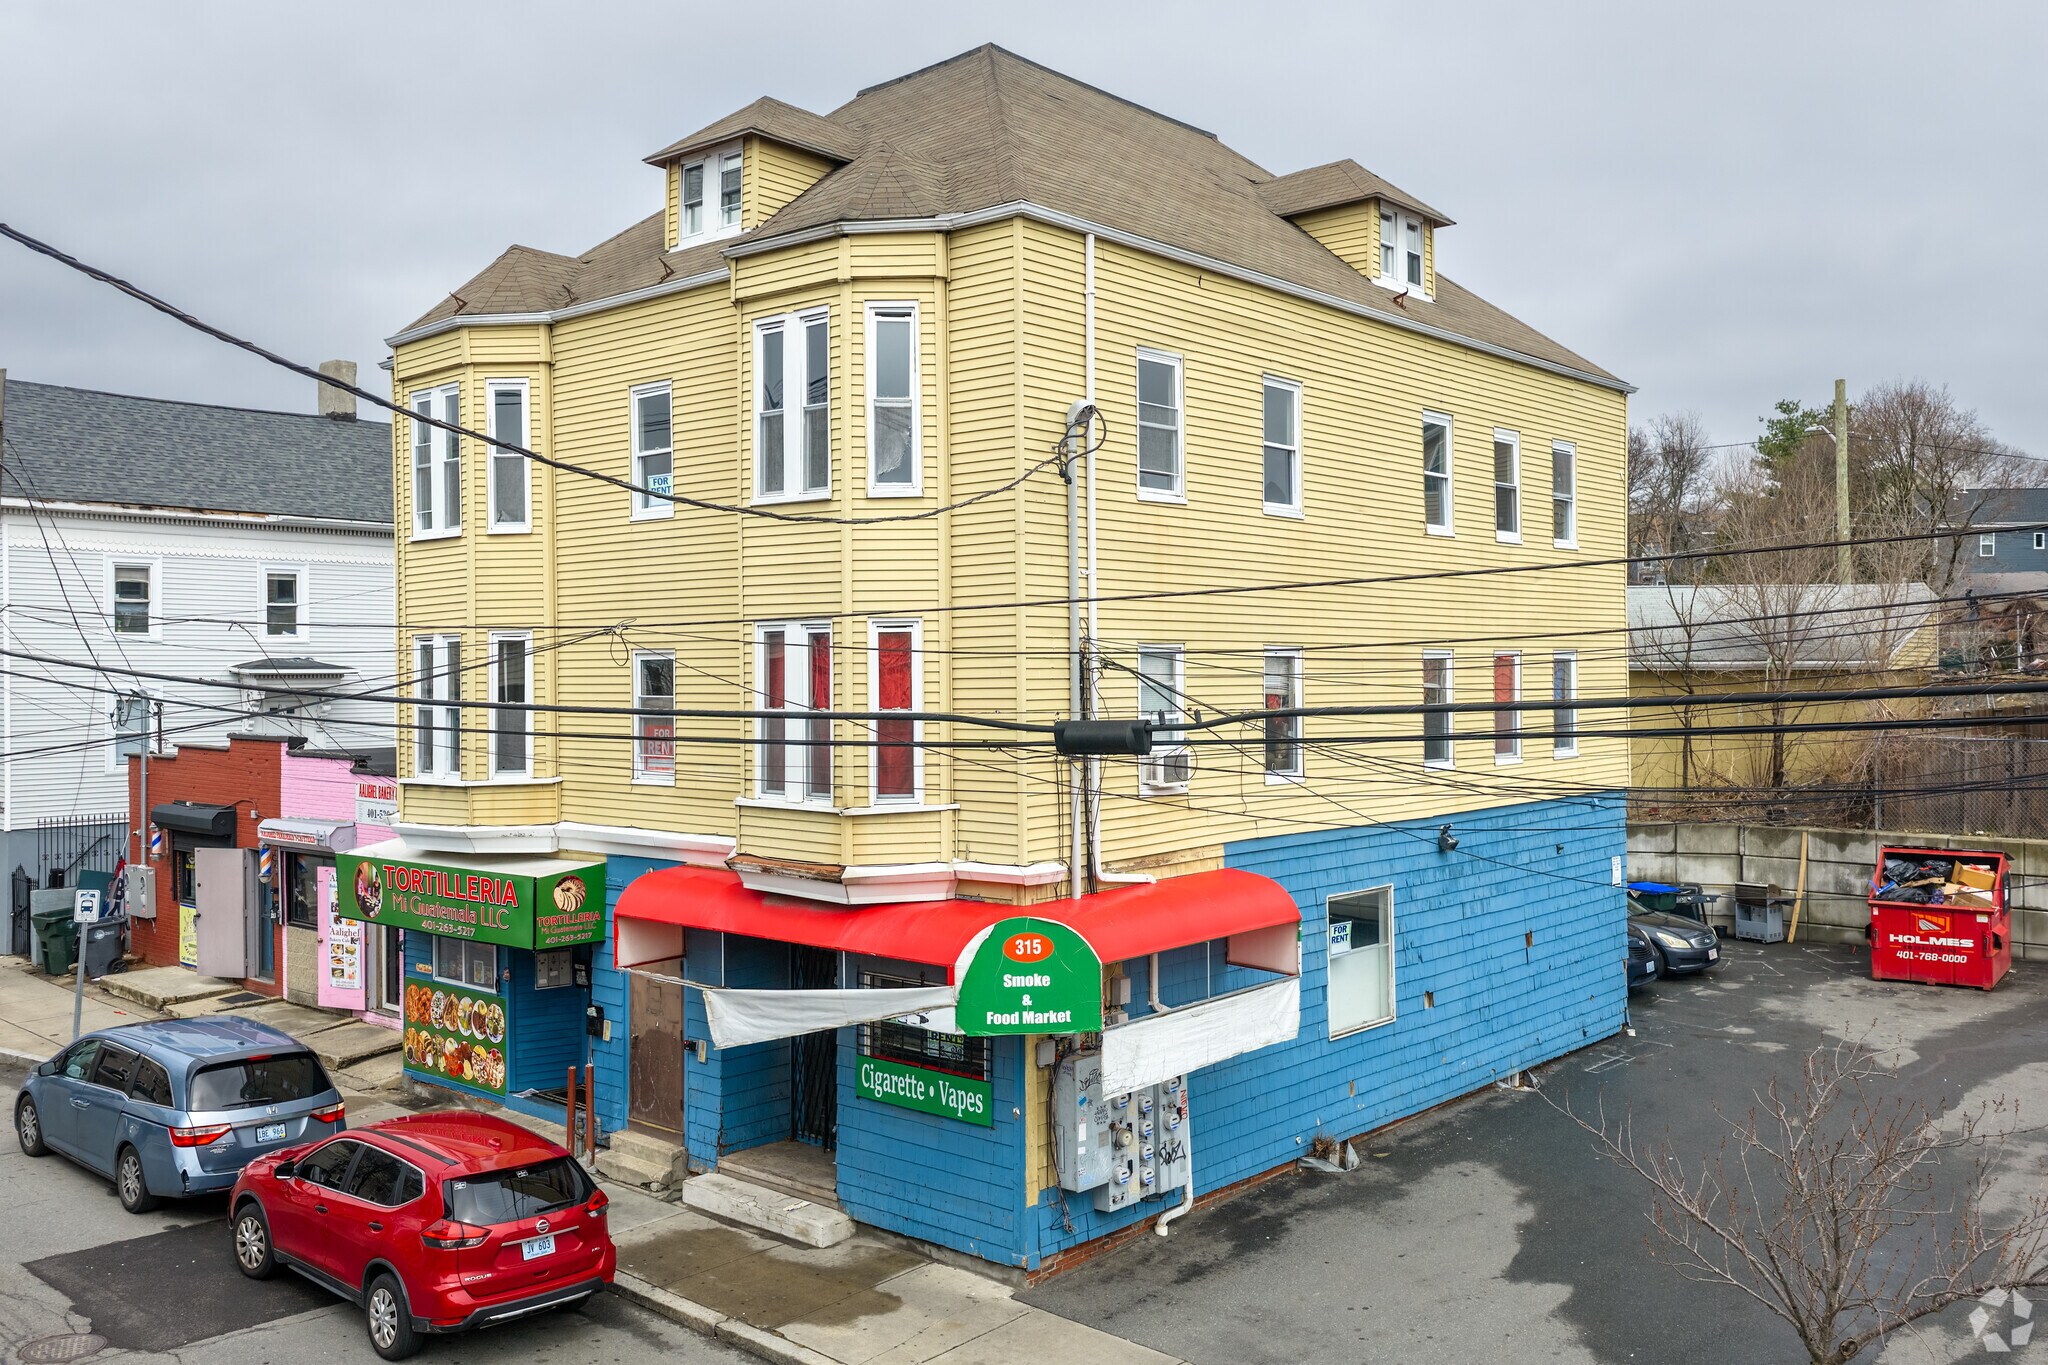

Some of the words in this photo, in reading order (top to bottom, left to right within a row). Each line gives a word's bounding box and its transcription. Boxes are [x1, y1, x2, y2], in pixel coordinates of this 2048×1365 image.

[653, 477, 669, 486] FOR
[654, 728, 670, 738] FOR
[383, 864, 518, 908] TORTILLERIA
[392, 893, 408, 912] Mi
[410, 895, 478, 925] Guatemala
[480, 905, 510, 930] LLC
[537, 911, 600, 927] TORTILLERIA
[421, 919, 475, 937] 401-263-5217
[1334, 925, 1347, 934] FOR
[545, 932, 593, 944] 401-263-5217
[1332, 934, 1348, 944] RENT
[1889, 933, 1974, 948] HOLMES
[1015, 939, 1042, 955] 315
[1896, 950, 1967, 963] 401-768-0000
[1003, 973, 1050, 987] Smoke
[1022, 994, 1032, 1006] &
[986, 1011, 1019, 1025] Food
[1022, 1010, 1071, 1025] Market
[861, 1063, 925, 1100] Cigarette
[939, 1080, 983, 1117] Vapes
[272, 1127, 284, 1136] 966
[527, 1243, 535, 1254] JV
[538, 1240, 551, 1250] 603
[464, 1273, 492, 1282] ROGUE
